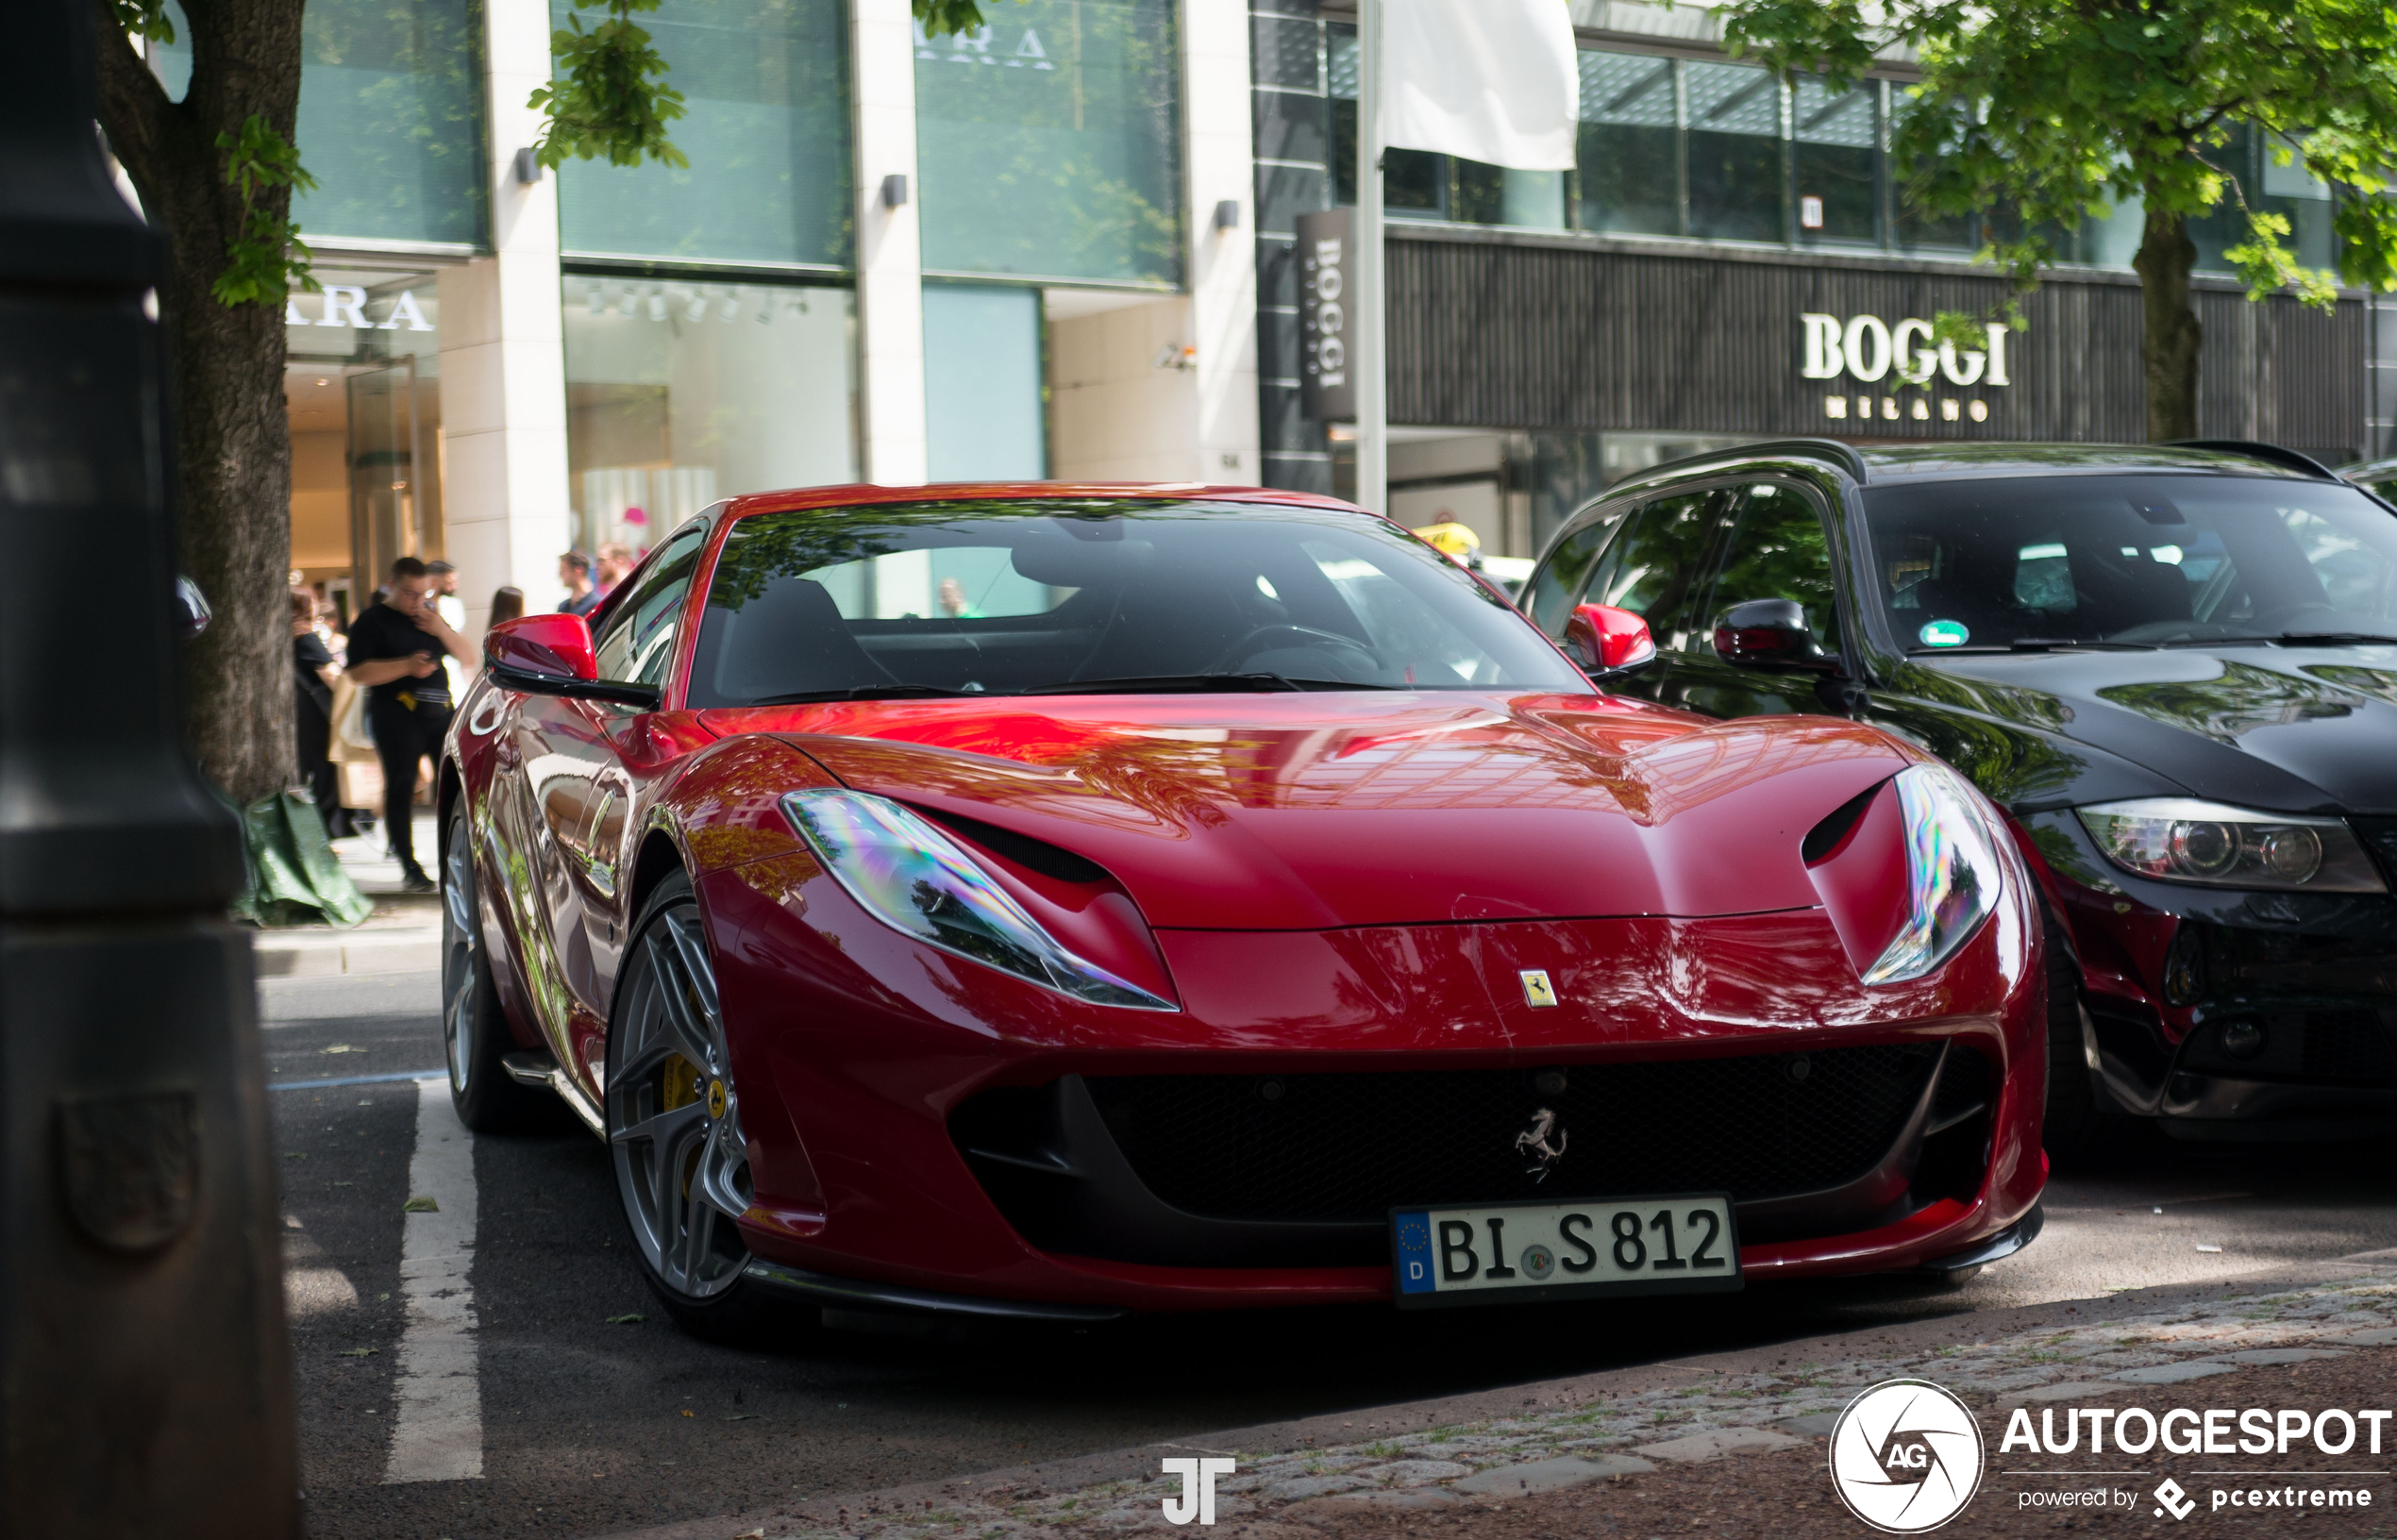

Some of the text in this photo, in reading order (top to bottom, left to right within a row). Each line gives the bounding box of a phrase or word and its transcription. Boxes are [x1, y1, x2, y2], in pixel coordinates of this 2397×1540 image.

[1316, 238, 1345, 388] BOGGI
[1800, 312, 2011, 386] BOGGI
[1824, 394, 1988, 422] MILANO
[1410, 1262, 1423, 1280] D
[1439, 1218, 1516, 1281] BI
